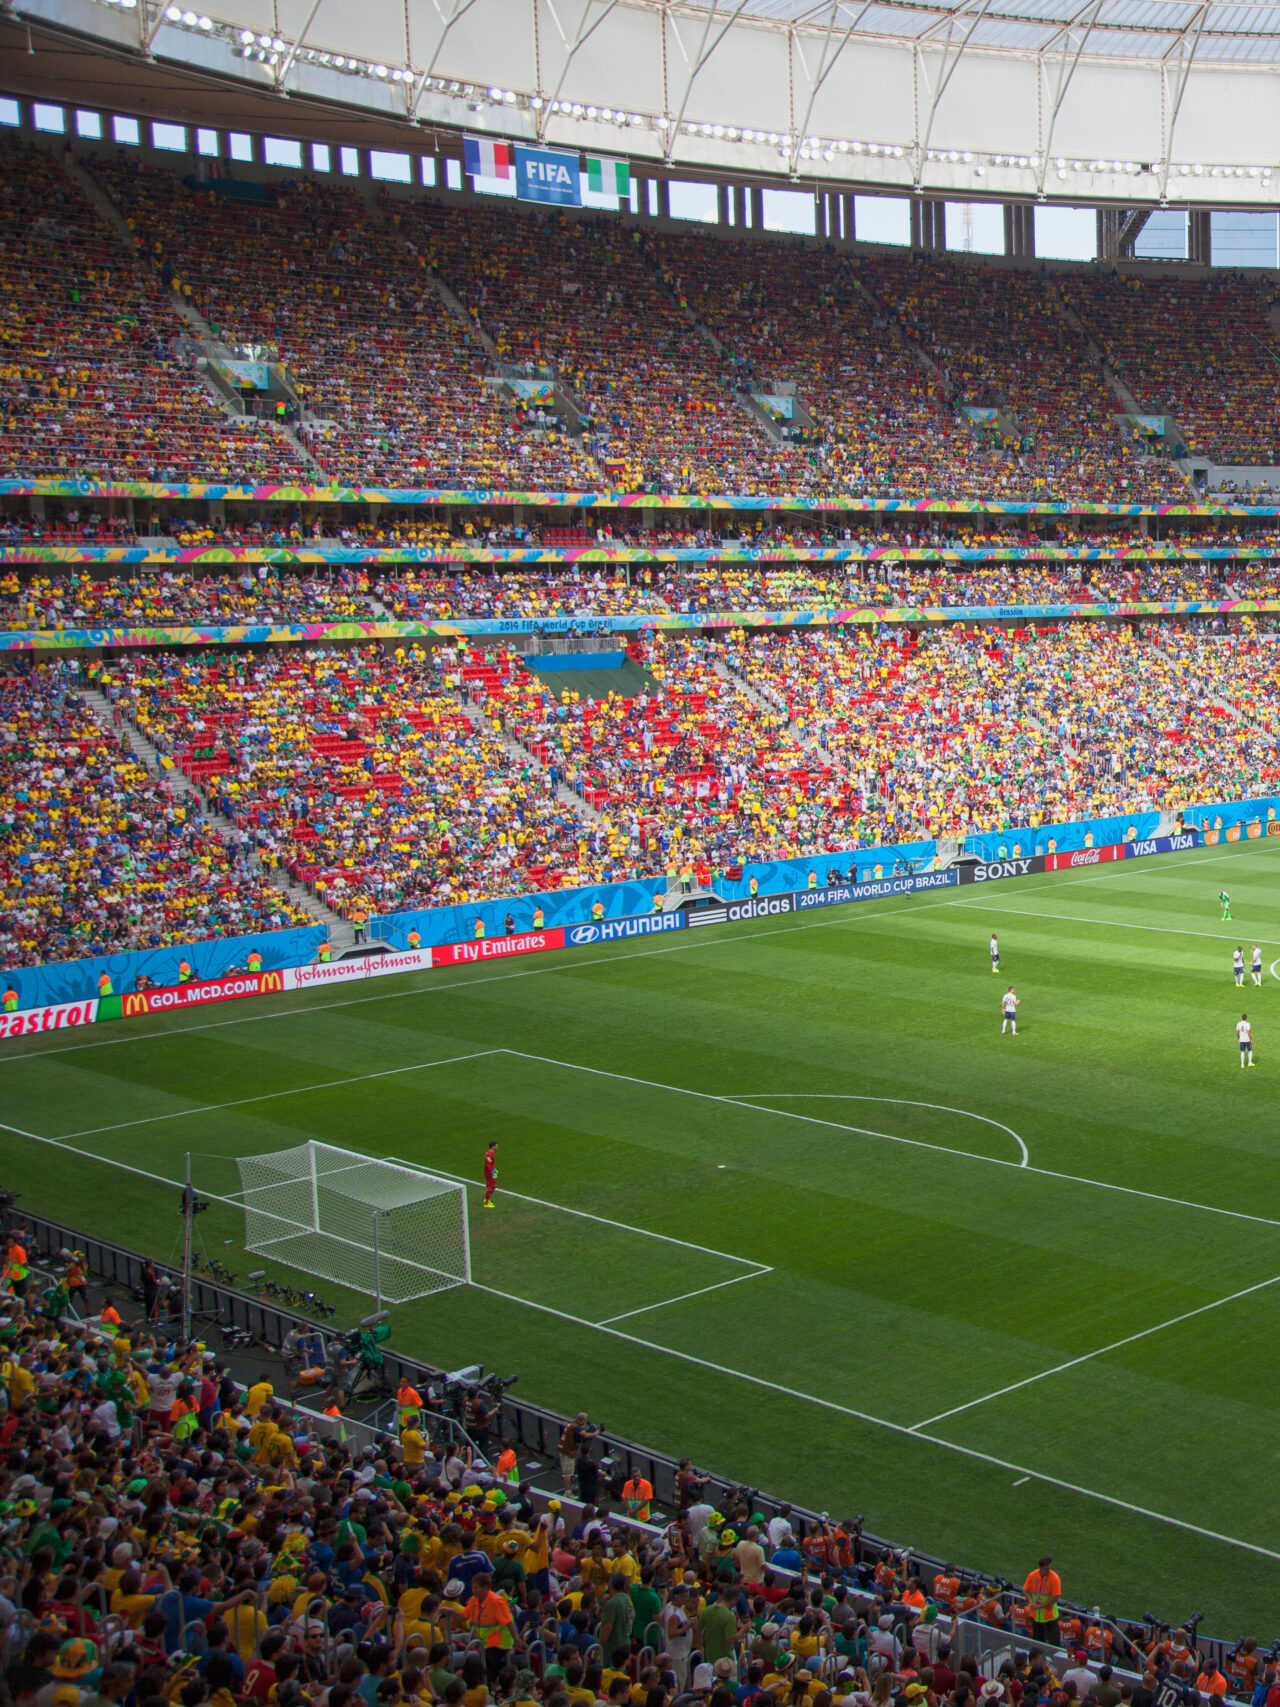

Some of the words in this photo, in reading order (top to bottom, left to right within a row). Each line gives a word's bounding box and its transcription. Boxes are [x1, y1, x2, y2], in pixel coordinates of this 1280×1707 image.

[526, 160, 572, 184] FIFA
[499, 621, 518, 631] 2014
[1131, 840, 1158, 856] VISA
[1169, 834, 1193, 850] VISA
[974, 859, 1032, 882] SONY
[801, 893, 825, 907] 2014
[828, 890, 850, 903] FIFA
[852, 883, 891, 899] WORLD
[893, 880, 914, 893] CUP
[915, 875, 950, 889] BRAZIL
[729, 898, 790, 921] adidas
[601, 912, 680, 939] HYUNDAI
[453, 942, 479, 961] Fly
[481, 933, 545, 956] Emirates
[150, 979, 259, 1008] GOL.MCD.COM
[242, 1669, 260, 1696] 9
[1156, 1685, 1177, 1707] 10
